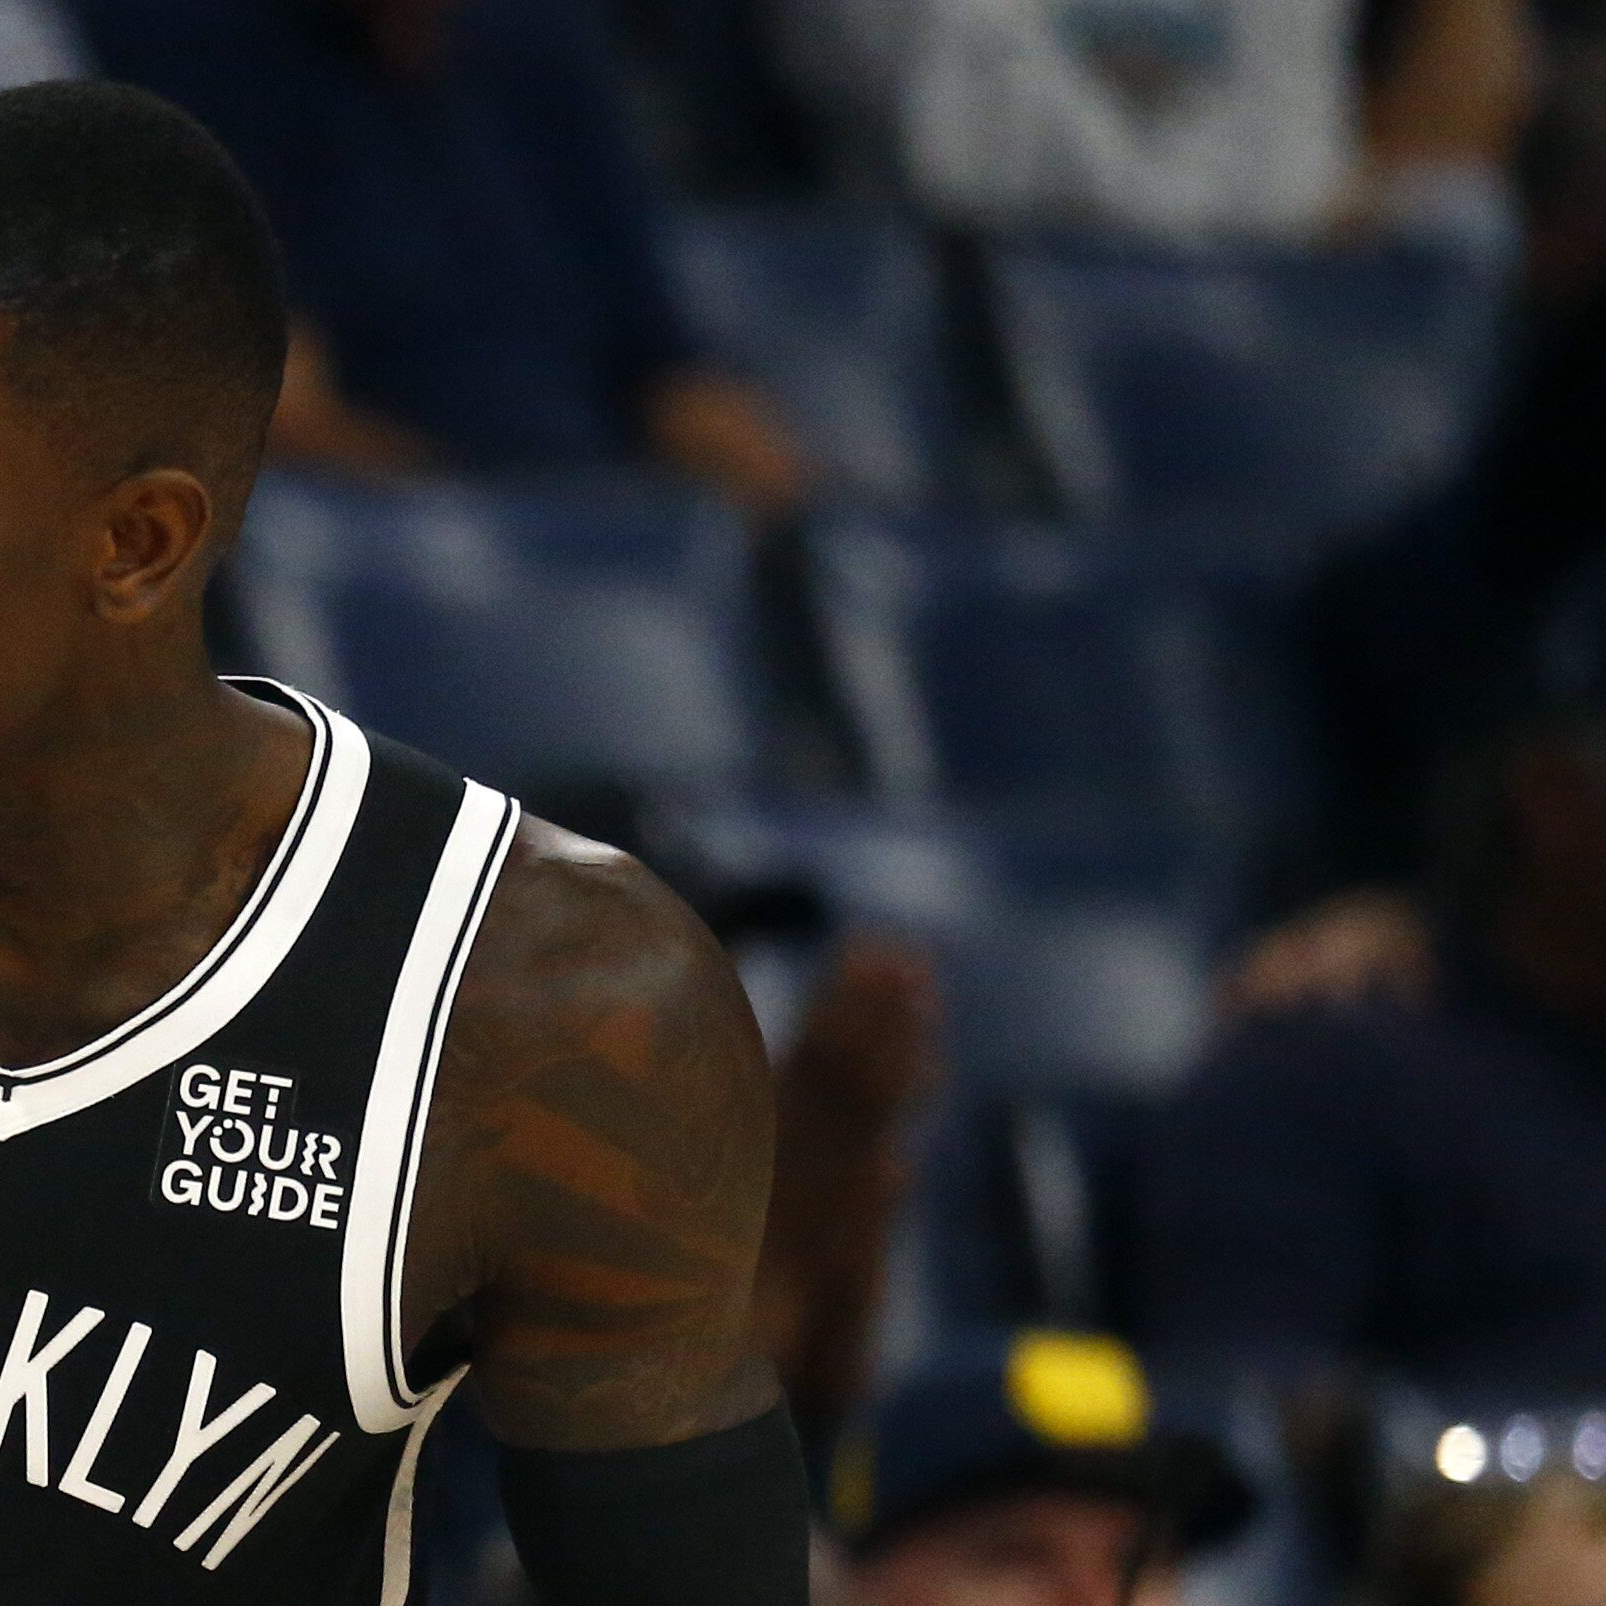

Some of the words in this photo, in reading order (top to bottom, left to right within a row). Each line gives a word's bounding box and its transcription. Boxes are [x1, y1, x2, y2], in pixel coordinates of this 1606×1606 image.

[179, 1064, 293, 1120] GET
[175, 1110, 341, 1180] YOUR
[161, 1159, 344, 1230] GUIDE
